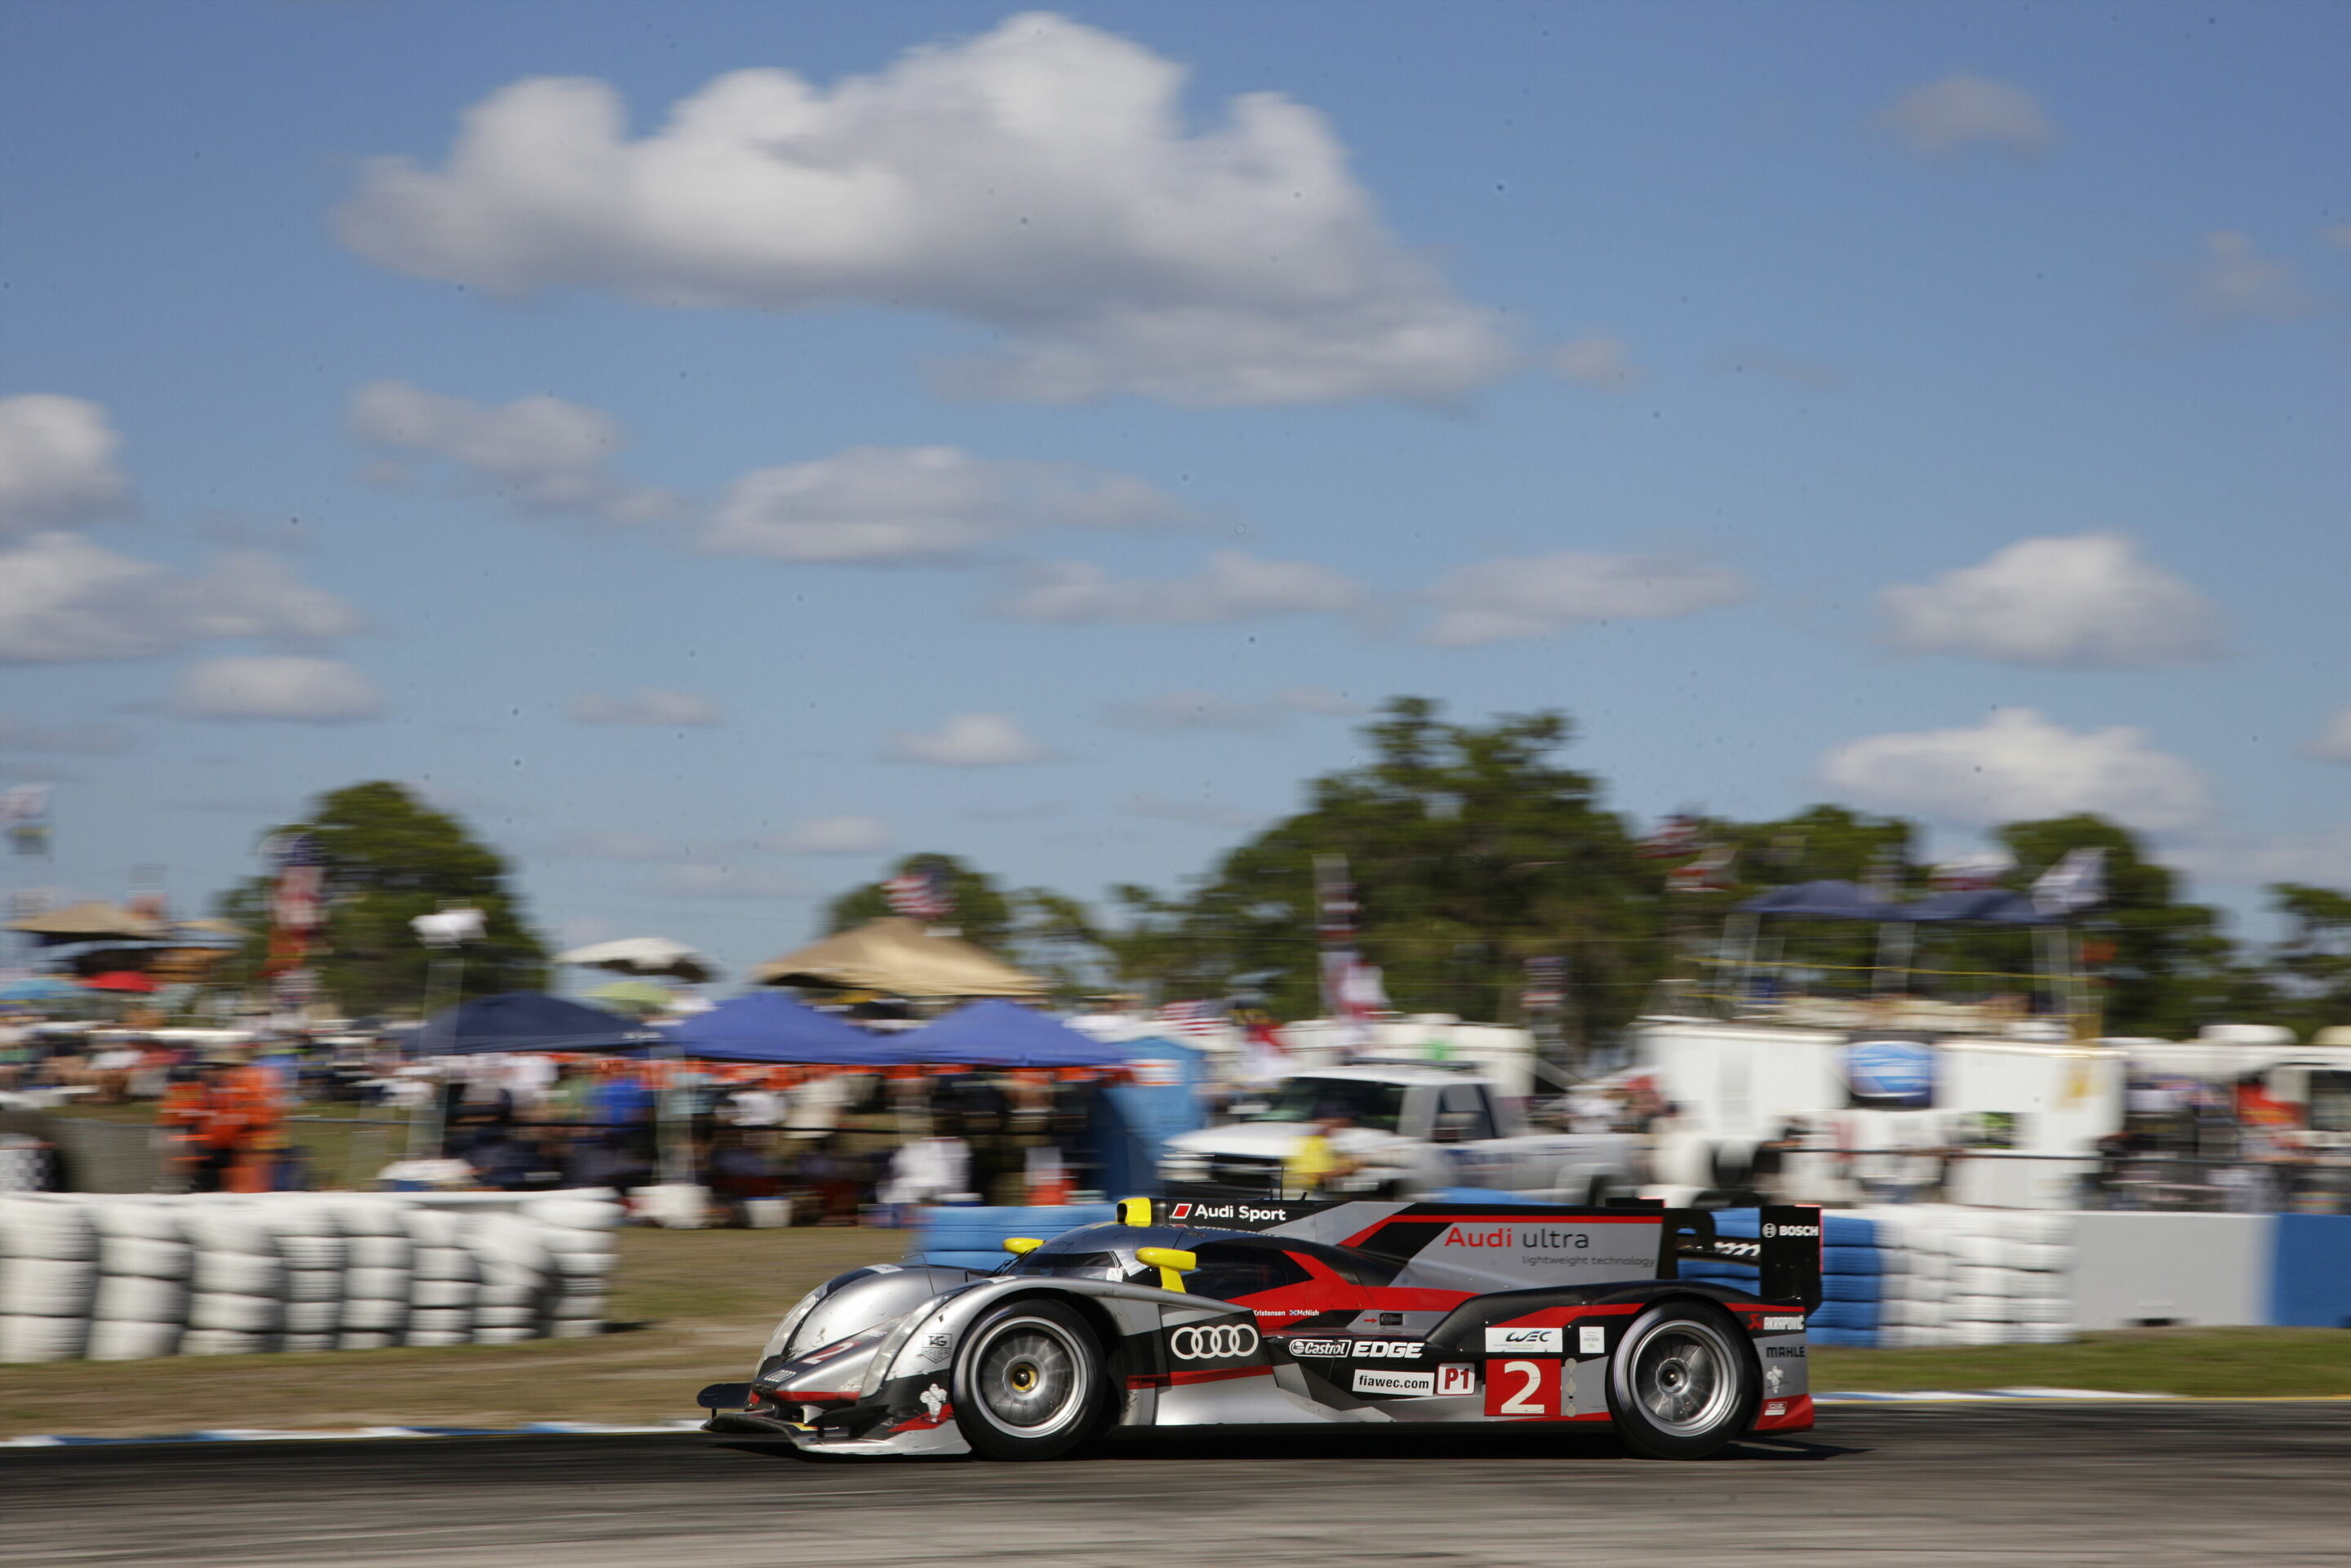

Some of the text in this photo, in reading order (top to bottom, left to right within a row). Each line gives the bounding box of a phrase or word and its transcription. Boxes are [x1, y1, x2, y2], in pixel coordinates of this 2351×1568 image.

[1194, 1204, 1287, 1222] Audi Sport
[1444, 1227, 1589, 1249] Audi ultra
[1779, 1225, 1820, 1237] BOSCH
[1522, 1255, 1655, 1268] lightweight technology
[1296, 1309, 1320, 1317] McNish
[1505, 1330, 1553, 1343] WEC
[802, 1342, 855, 1365] 2
[1304, 1339, 1425, 1358] Castrol EDGE
[1767, 1346, 1806, 1357] MAHLE
[1358, 1375, 1429, 1389] fiawec.com
[1444, 1368, 1469, 1390] P1
[1500, 1361, 1545, 1414] 2
